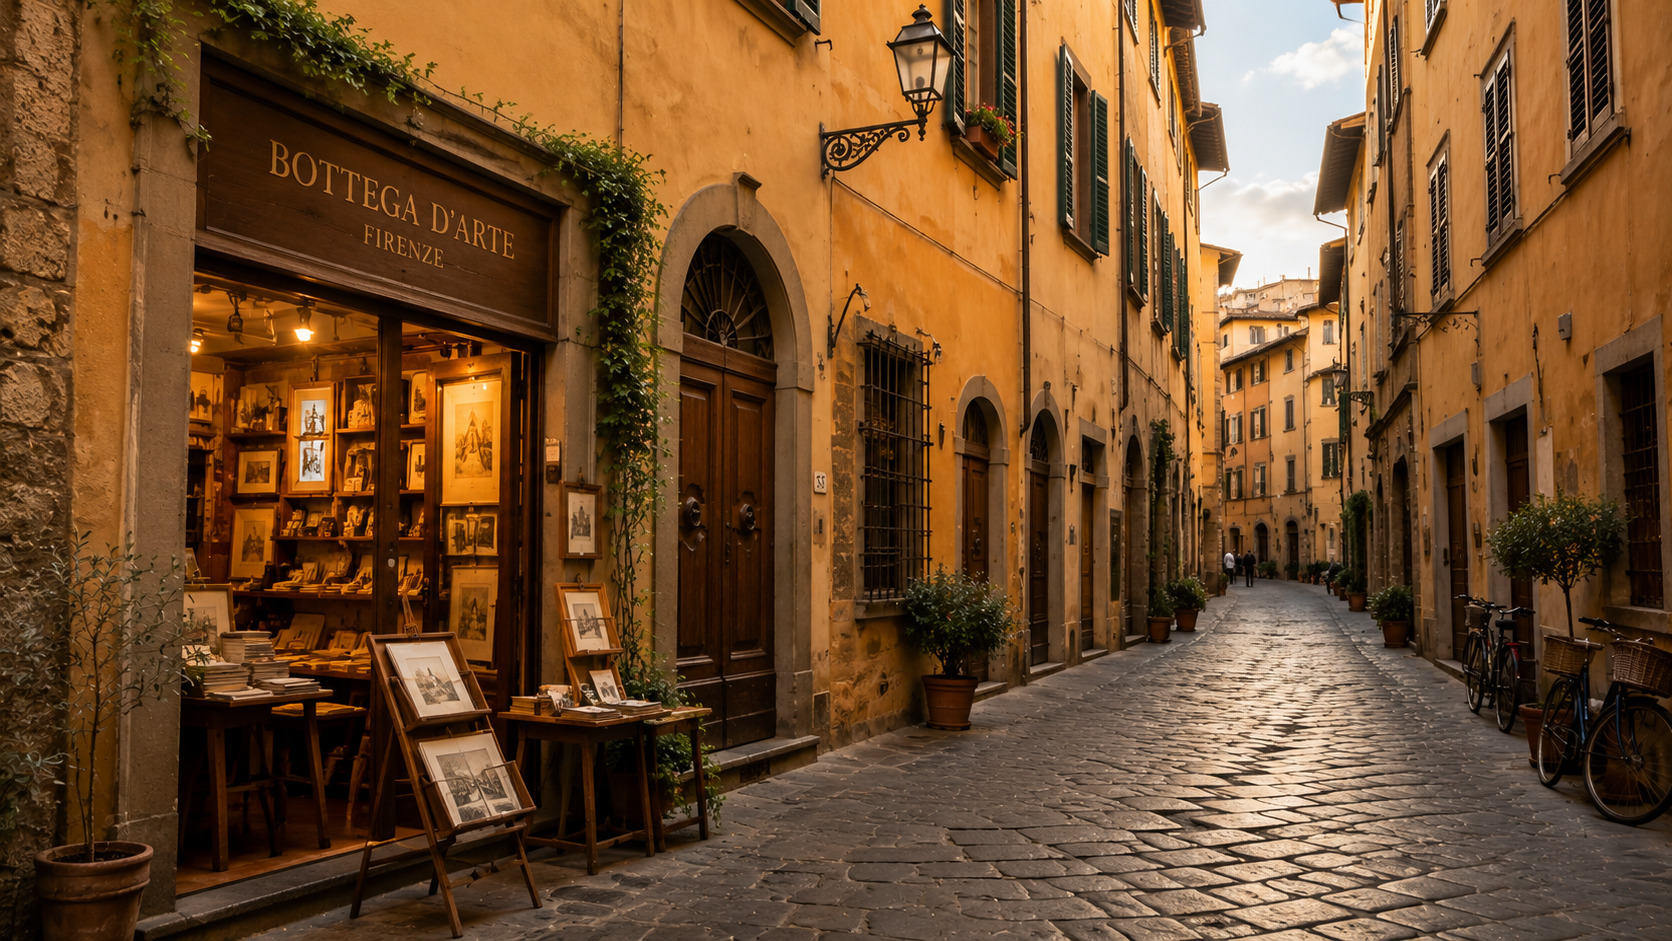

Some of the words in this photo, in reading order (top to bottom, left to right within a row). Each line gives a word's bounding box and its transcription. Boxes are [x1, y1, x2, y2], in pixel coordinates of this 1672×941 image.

[269, 139, 420, 226] BOTTEGA
[430, 202, 515, 260] D'ARTE
[364, 224, 444, 269] FIRENZE
